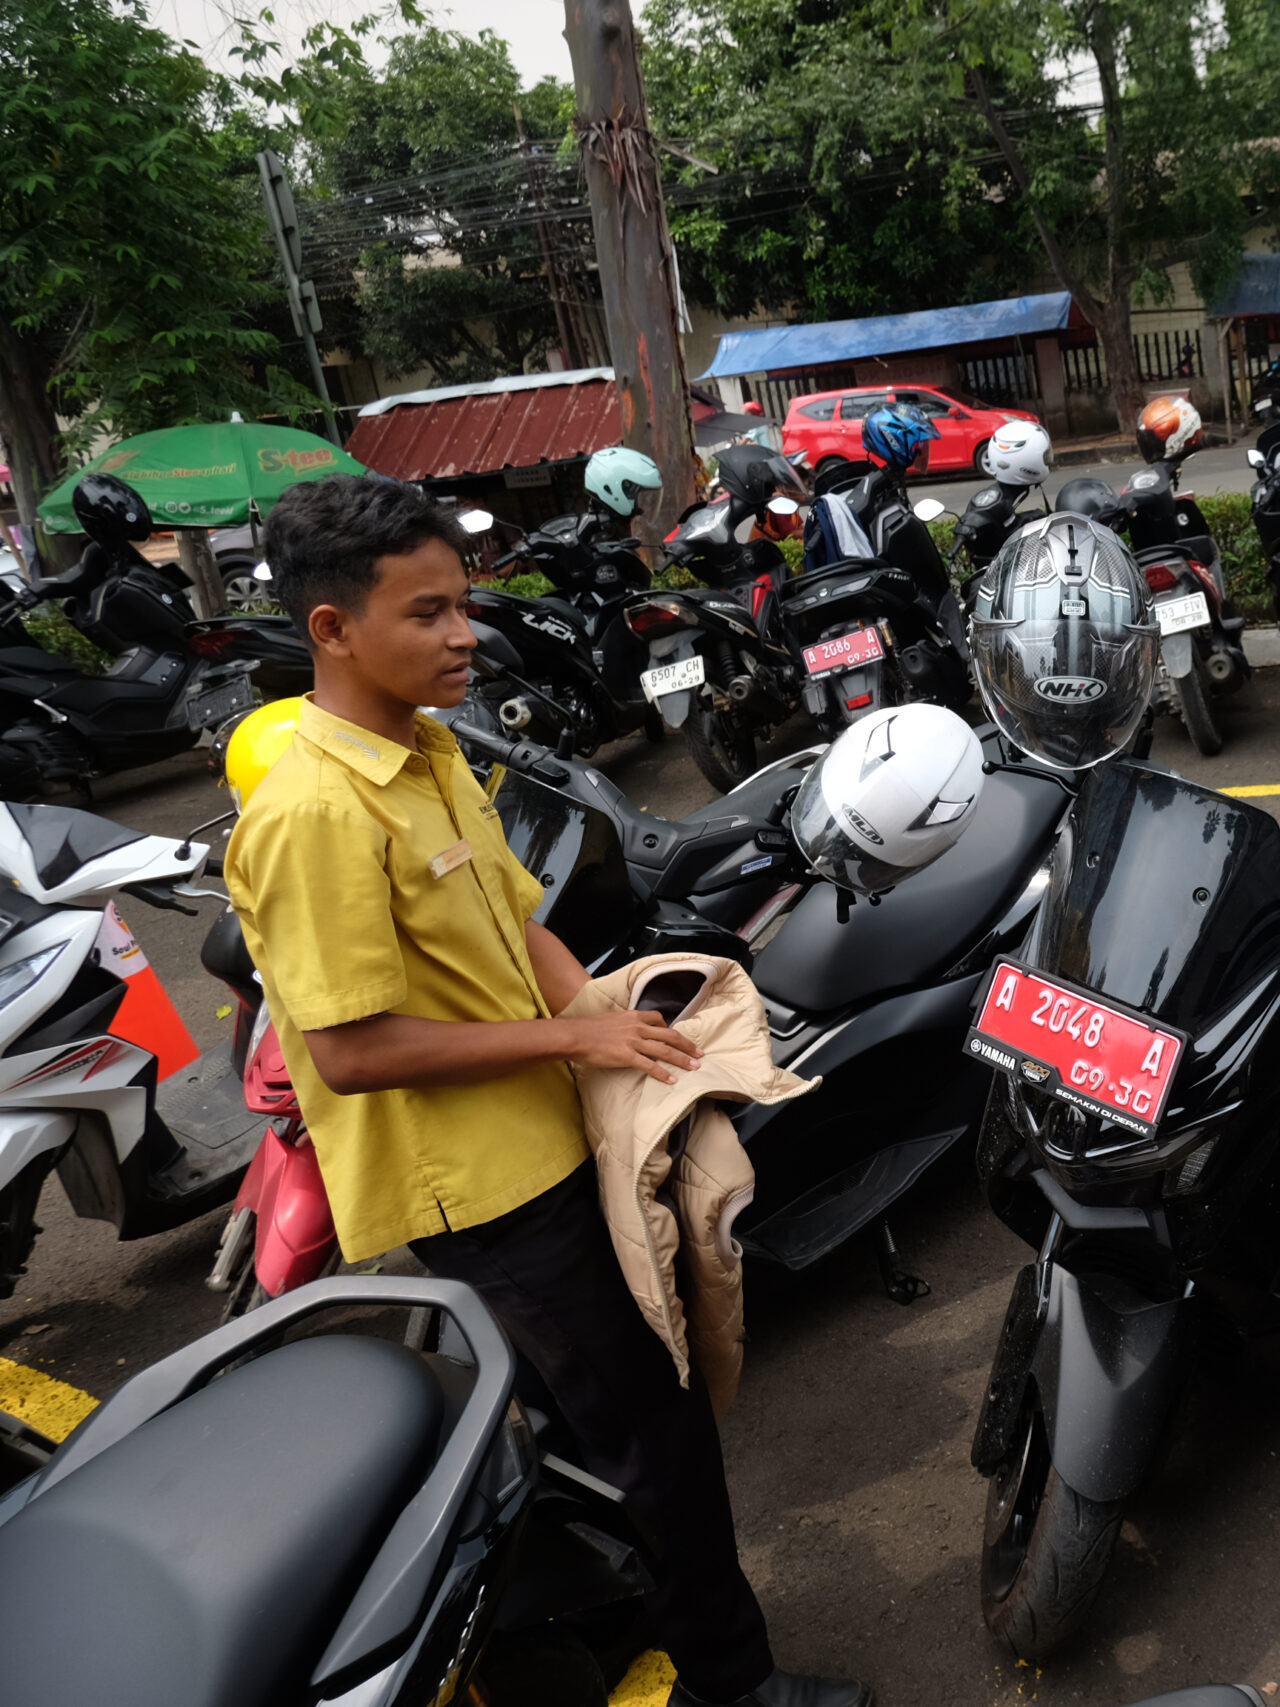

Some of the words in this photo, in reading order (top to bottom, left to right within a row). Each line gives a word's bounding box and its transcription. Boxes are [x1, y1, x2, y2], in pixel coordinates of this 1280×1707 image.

[808, 650, 817, 664] A
[822, 639, 851, 659] 2086
[866, 630, 875, 645] A
[651, 665, 676, 682] 6507
[686, 659, 700, 673] CH
[1042, 682, 1098, 697] NHK
[995, 975, 1017, 1012] A
[1031, 990, 1105, 1048] 2048
[1141, 1038, 1165, 1077] A
[980, 1043, 1017, 1071] YAMAHA
[1055, 1088, 1101, 1113] SEMAKIN
[1112, 1114, 1149, 1134] DEPAN
